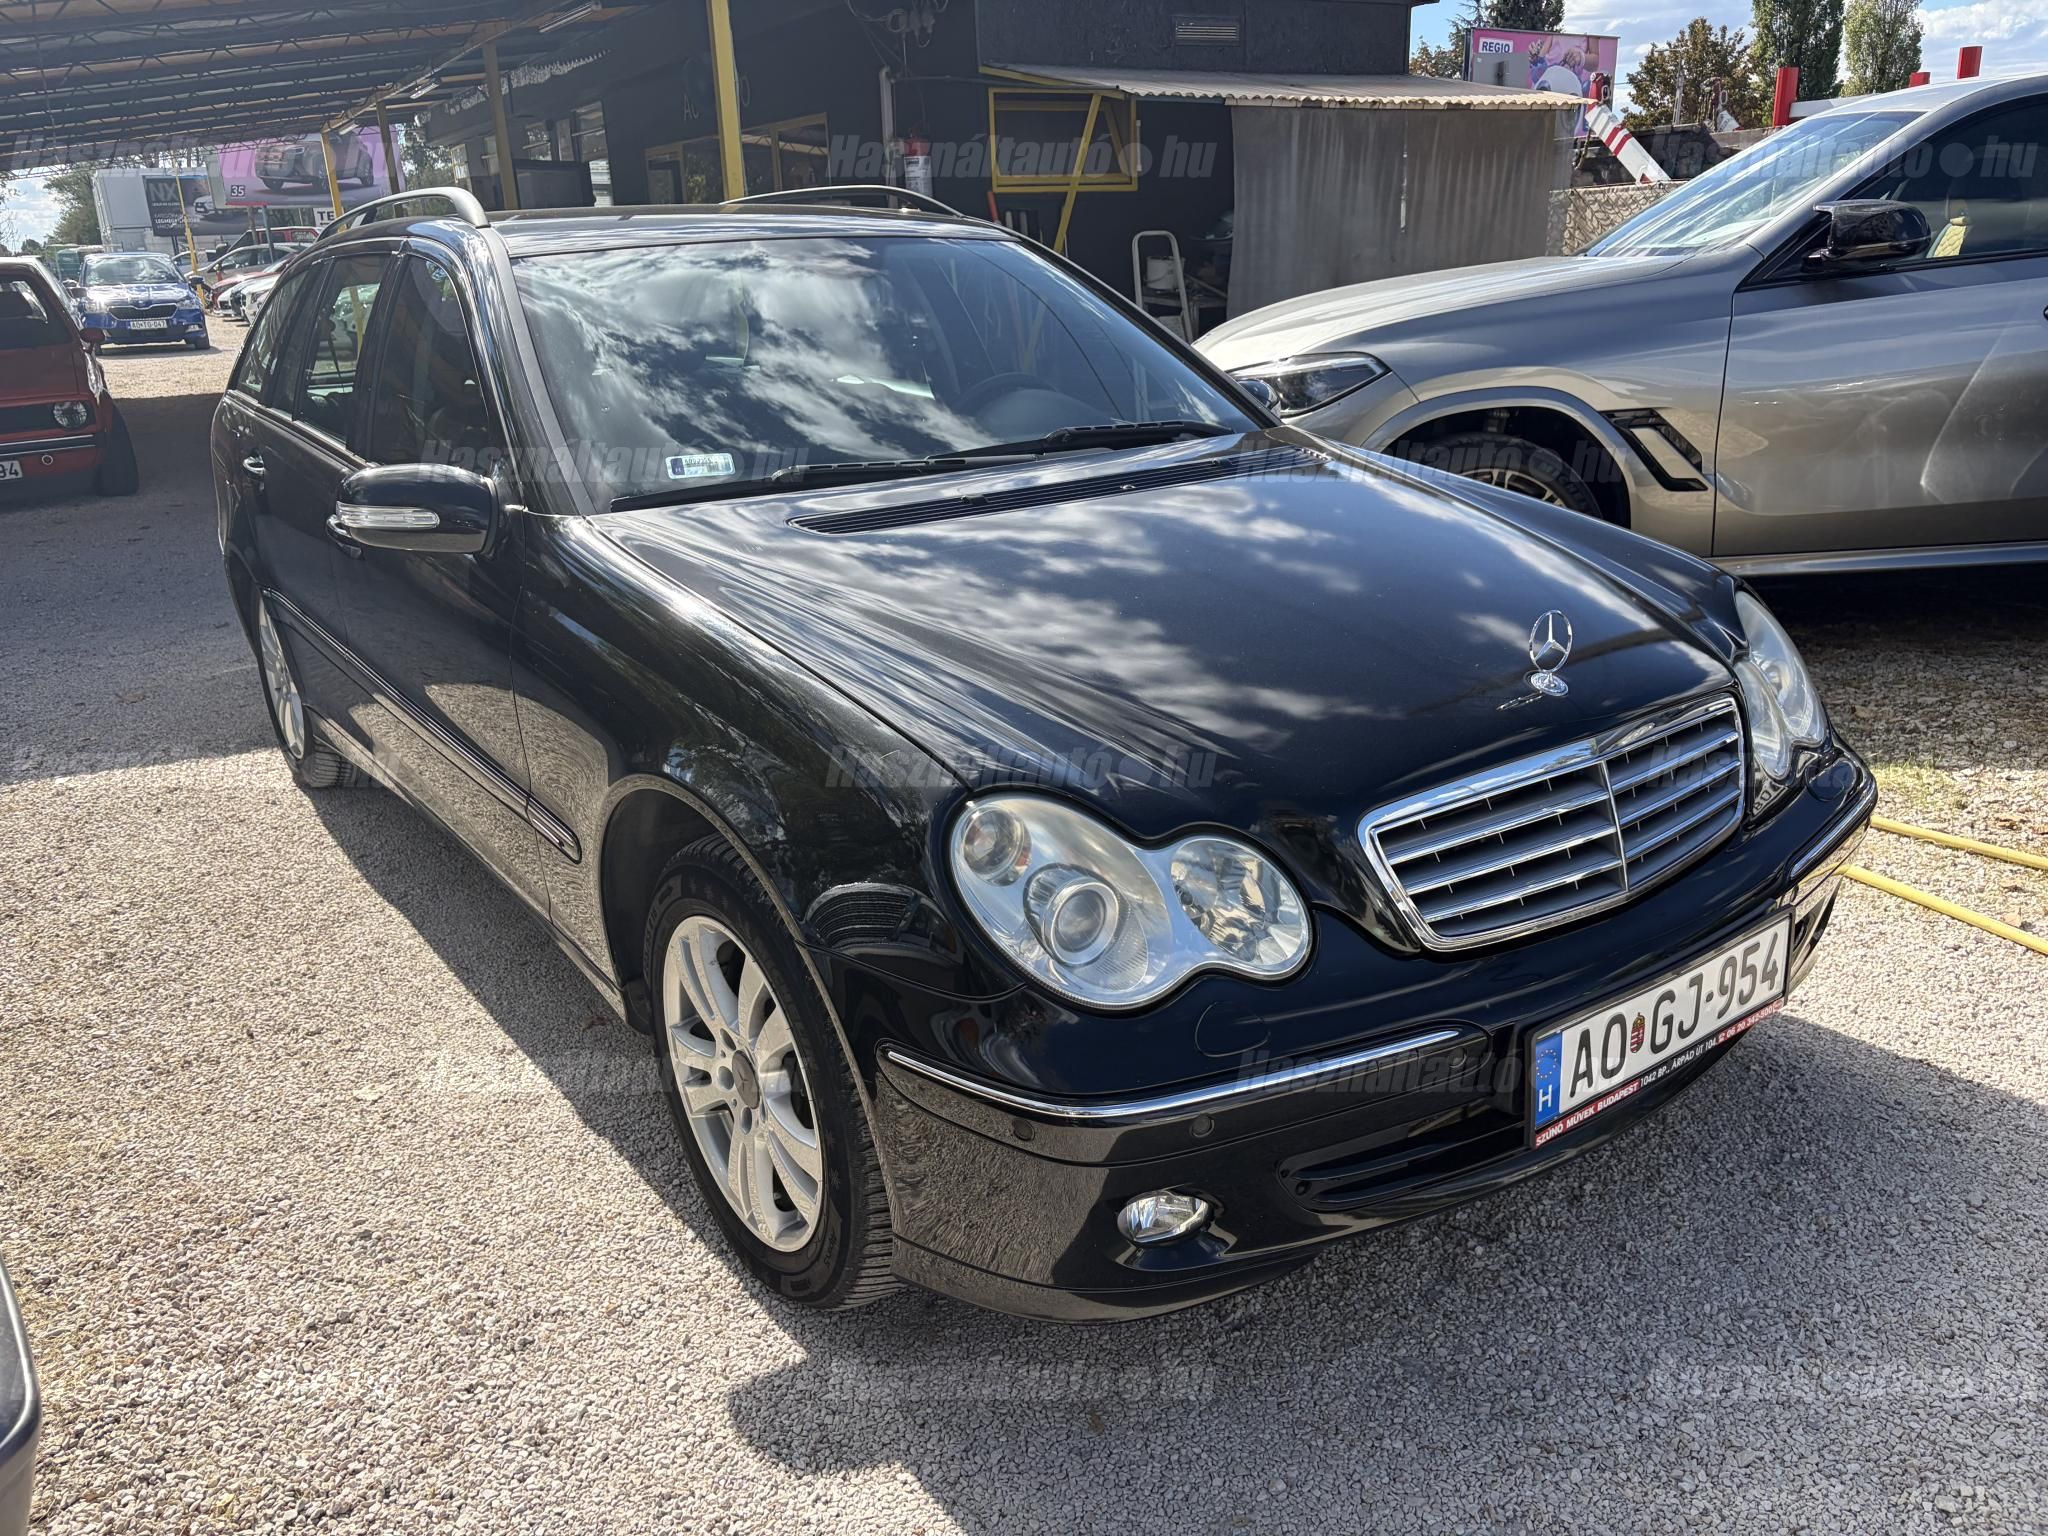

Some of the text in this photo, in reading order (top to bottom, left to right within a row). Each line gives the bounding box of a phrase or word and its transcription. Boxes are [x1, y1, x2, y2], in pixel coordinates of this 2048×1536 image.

[1482, 41, 1511, 54] REGIO
[148, 182, 180, 201] NX
[231, 186, 245, 196] 35
[1597, 1081, 1640, 1111] BUDAPEST
[1640, 1070, 1656, 1087] 1042
[1671, 1050, 1695, 1070] ÁRPÁD
[1696, 1043, 1704, 1057] ÚT
[1538, 1084, 1553, 1112] H
